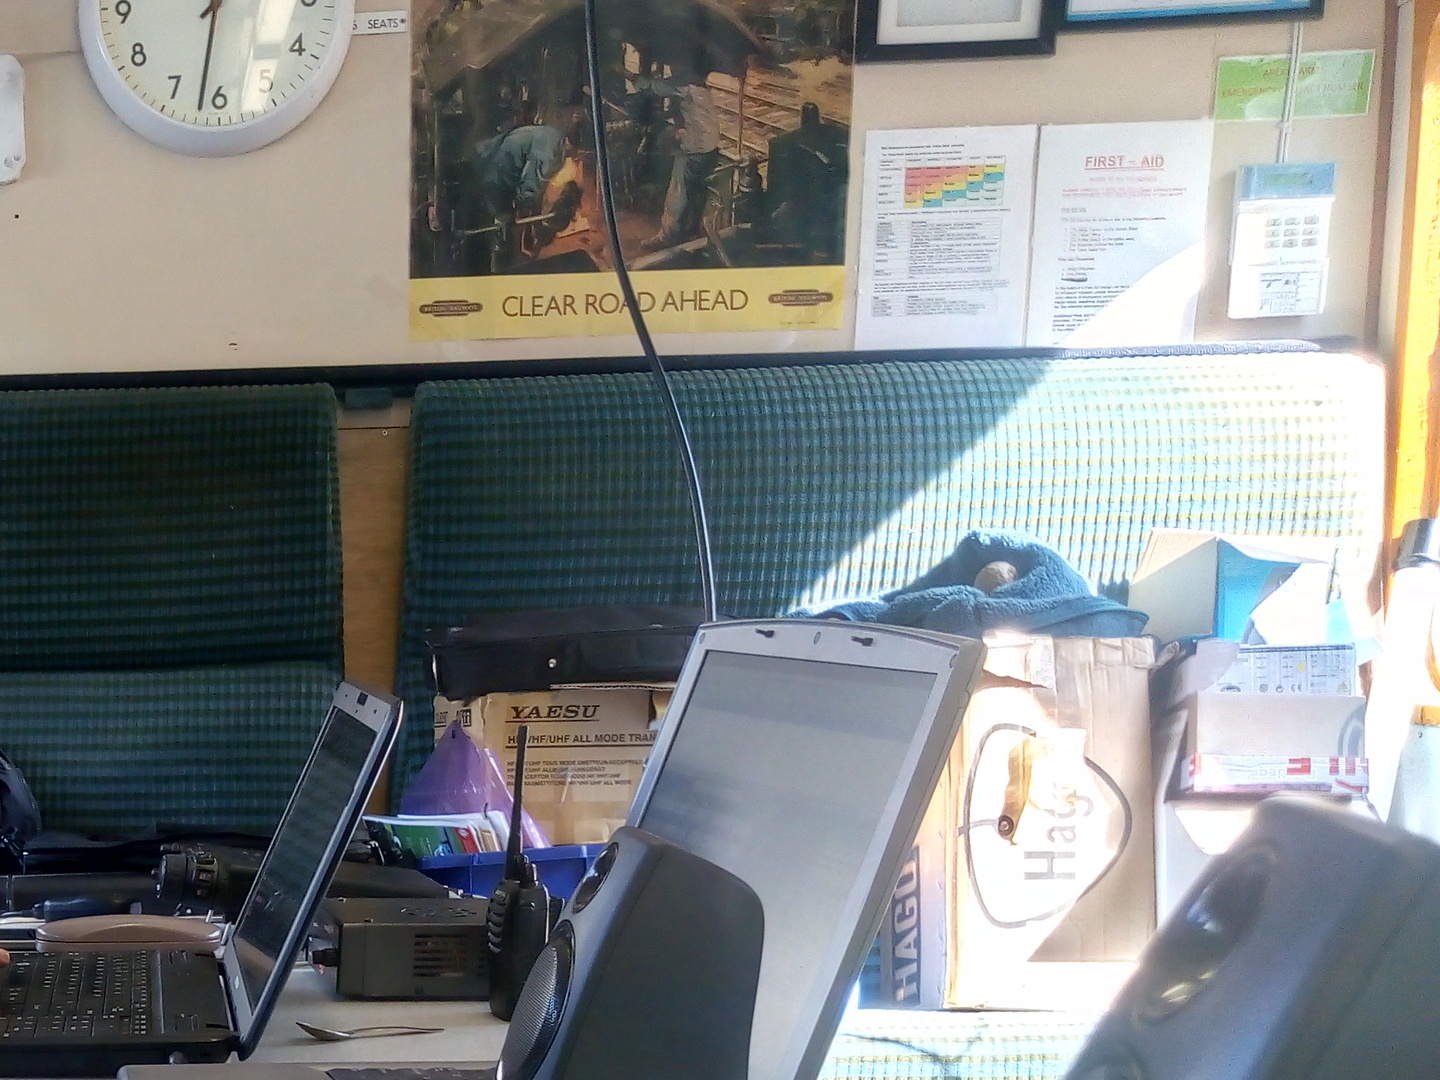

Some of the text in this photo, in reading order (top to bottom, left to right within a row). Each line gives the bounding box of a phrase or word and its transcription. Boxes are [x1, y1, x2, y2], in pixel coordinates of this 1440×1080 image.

[115, 1, 131, 25] 9
[367, 18, 399, 29] SEATS
[131, 43, 147, 67] 8
[289, 33, 306, 57] 4
[167, 75, 183, 99] 7
[258, 69, 274, 93] 5
[211, 86, 228, 110] 6
[1085, 155, 1125, 168] FIRST
[1140, 155, 1165, 168] AID
[502, 295, 578, 318] CLEAR
[661, 289, 749, 313] AHEAD
[510, 705, 600, 719] YAESU
[572, 735, 593, 743] ALL
[594, 733, 626, 743] MODE
[1024, 794, 1094, 880] Hag
